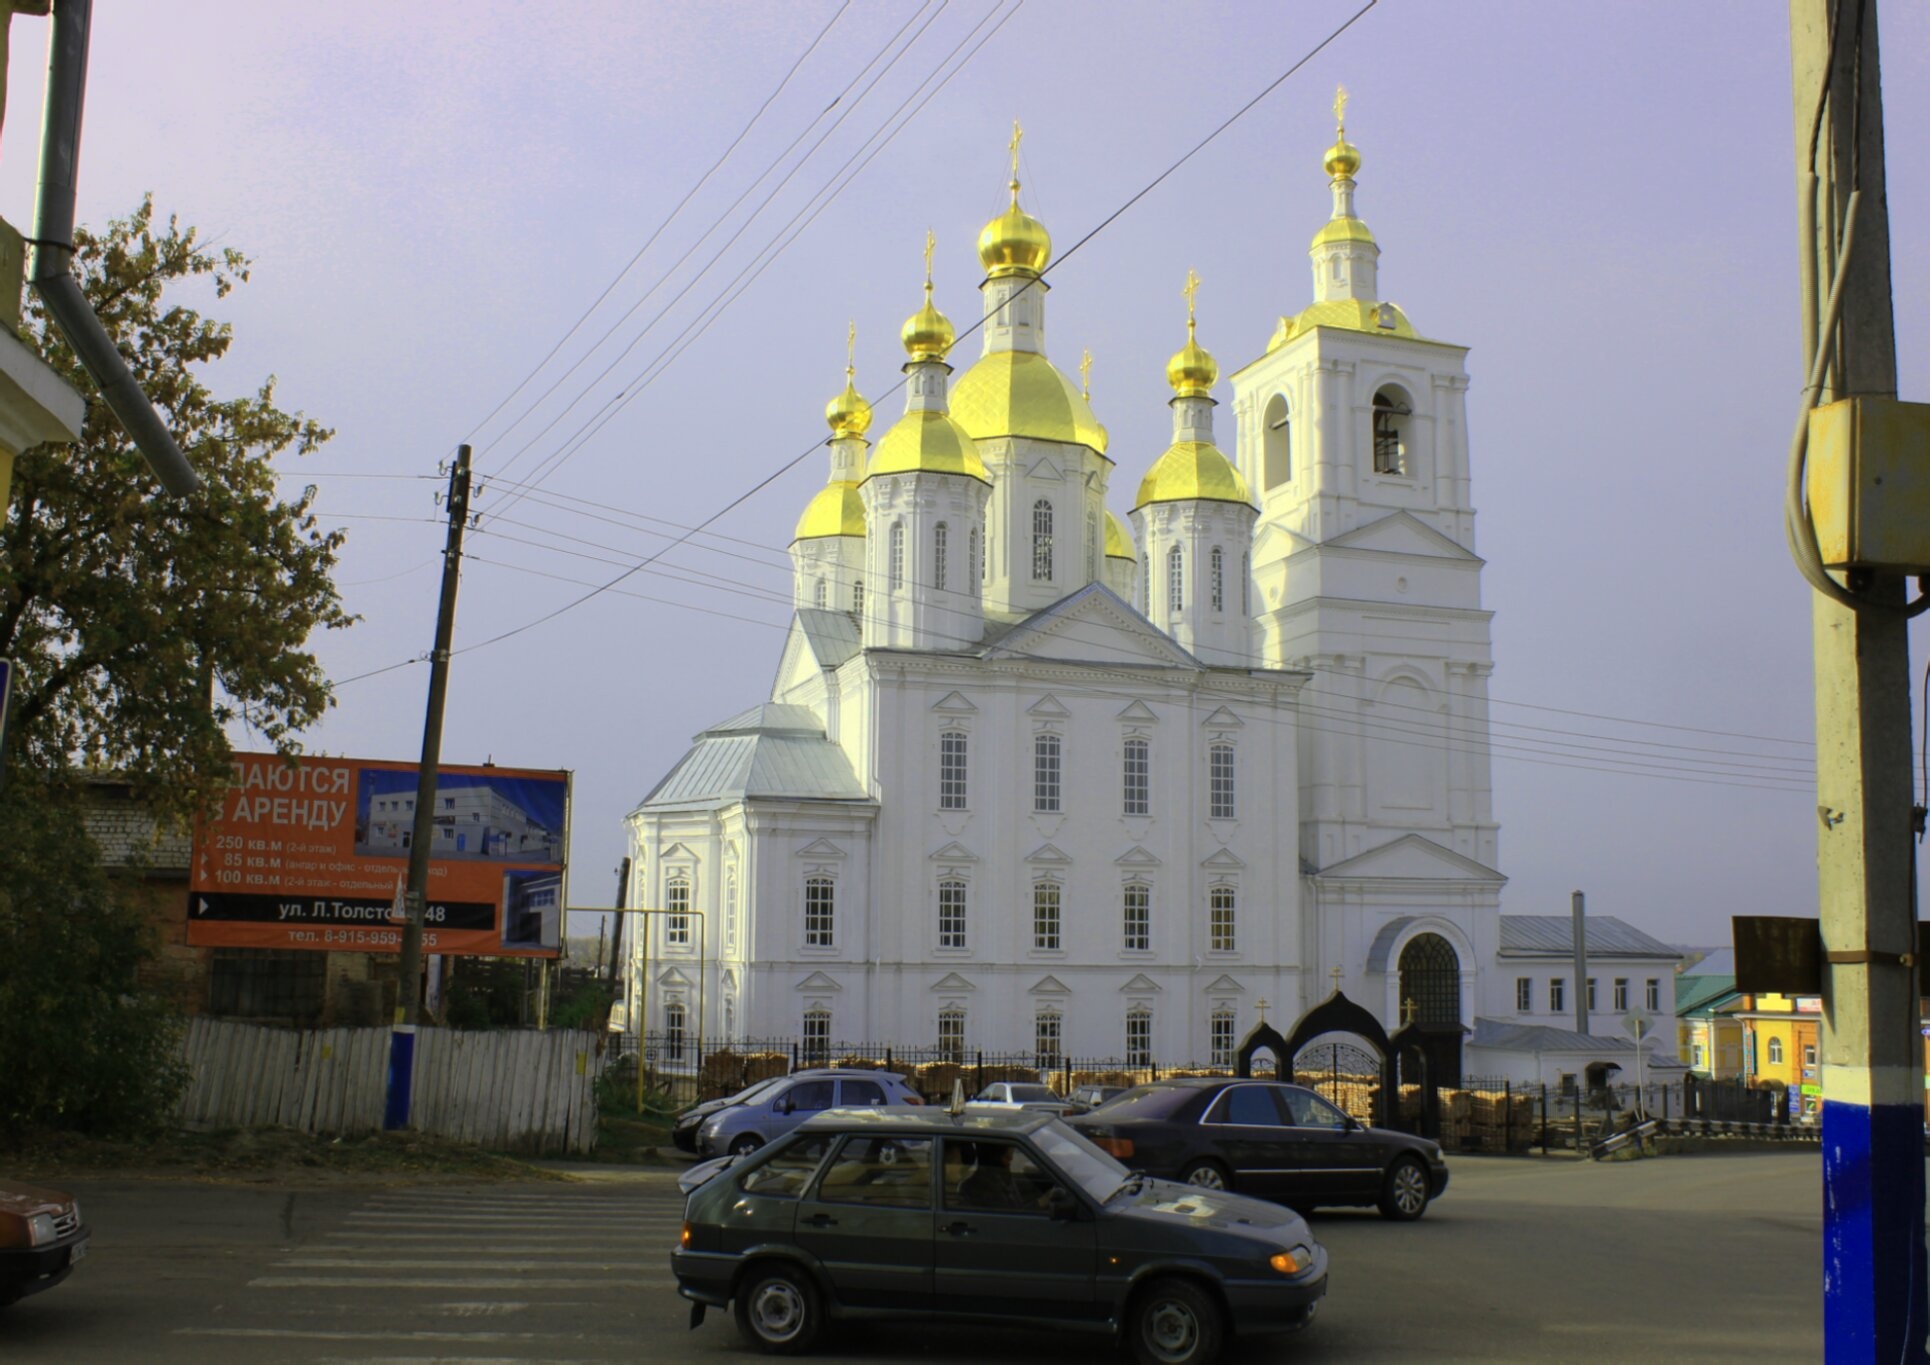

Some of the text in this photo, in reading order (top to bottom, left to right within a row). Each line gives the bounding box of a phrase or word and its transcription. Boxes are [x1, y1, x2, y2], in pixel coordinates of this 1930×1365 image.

[224, 762, 350, 794] ДАЮТСЯ
[232, 796, 347, 831] АРЕНДУ
[215, 835, 243, 849] 250
[248, 839, 282, 851] кв.м
[224, 852, 242, 866] 85
[247, 856, 281, 868] кв.м
[215, 870, 241, 884] 100
[246, 873, 280, 886] кв.м
[279, 901, 446, 922] ул. Л.Толсто 48
[288, 930, 319, 942] тел.
